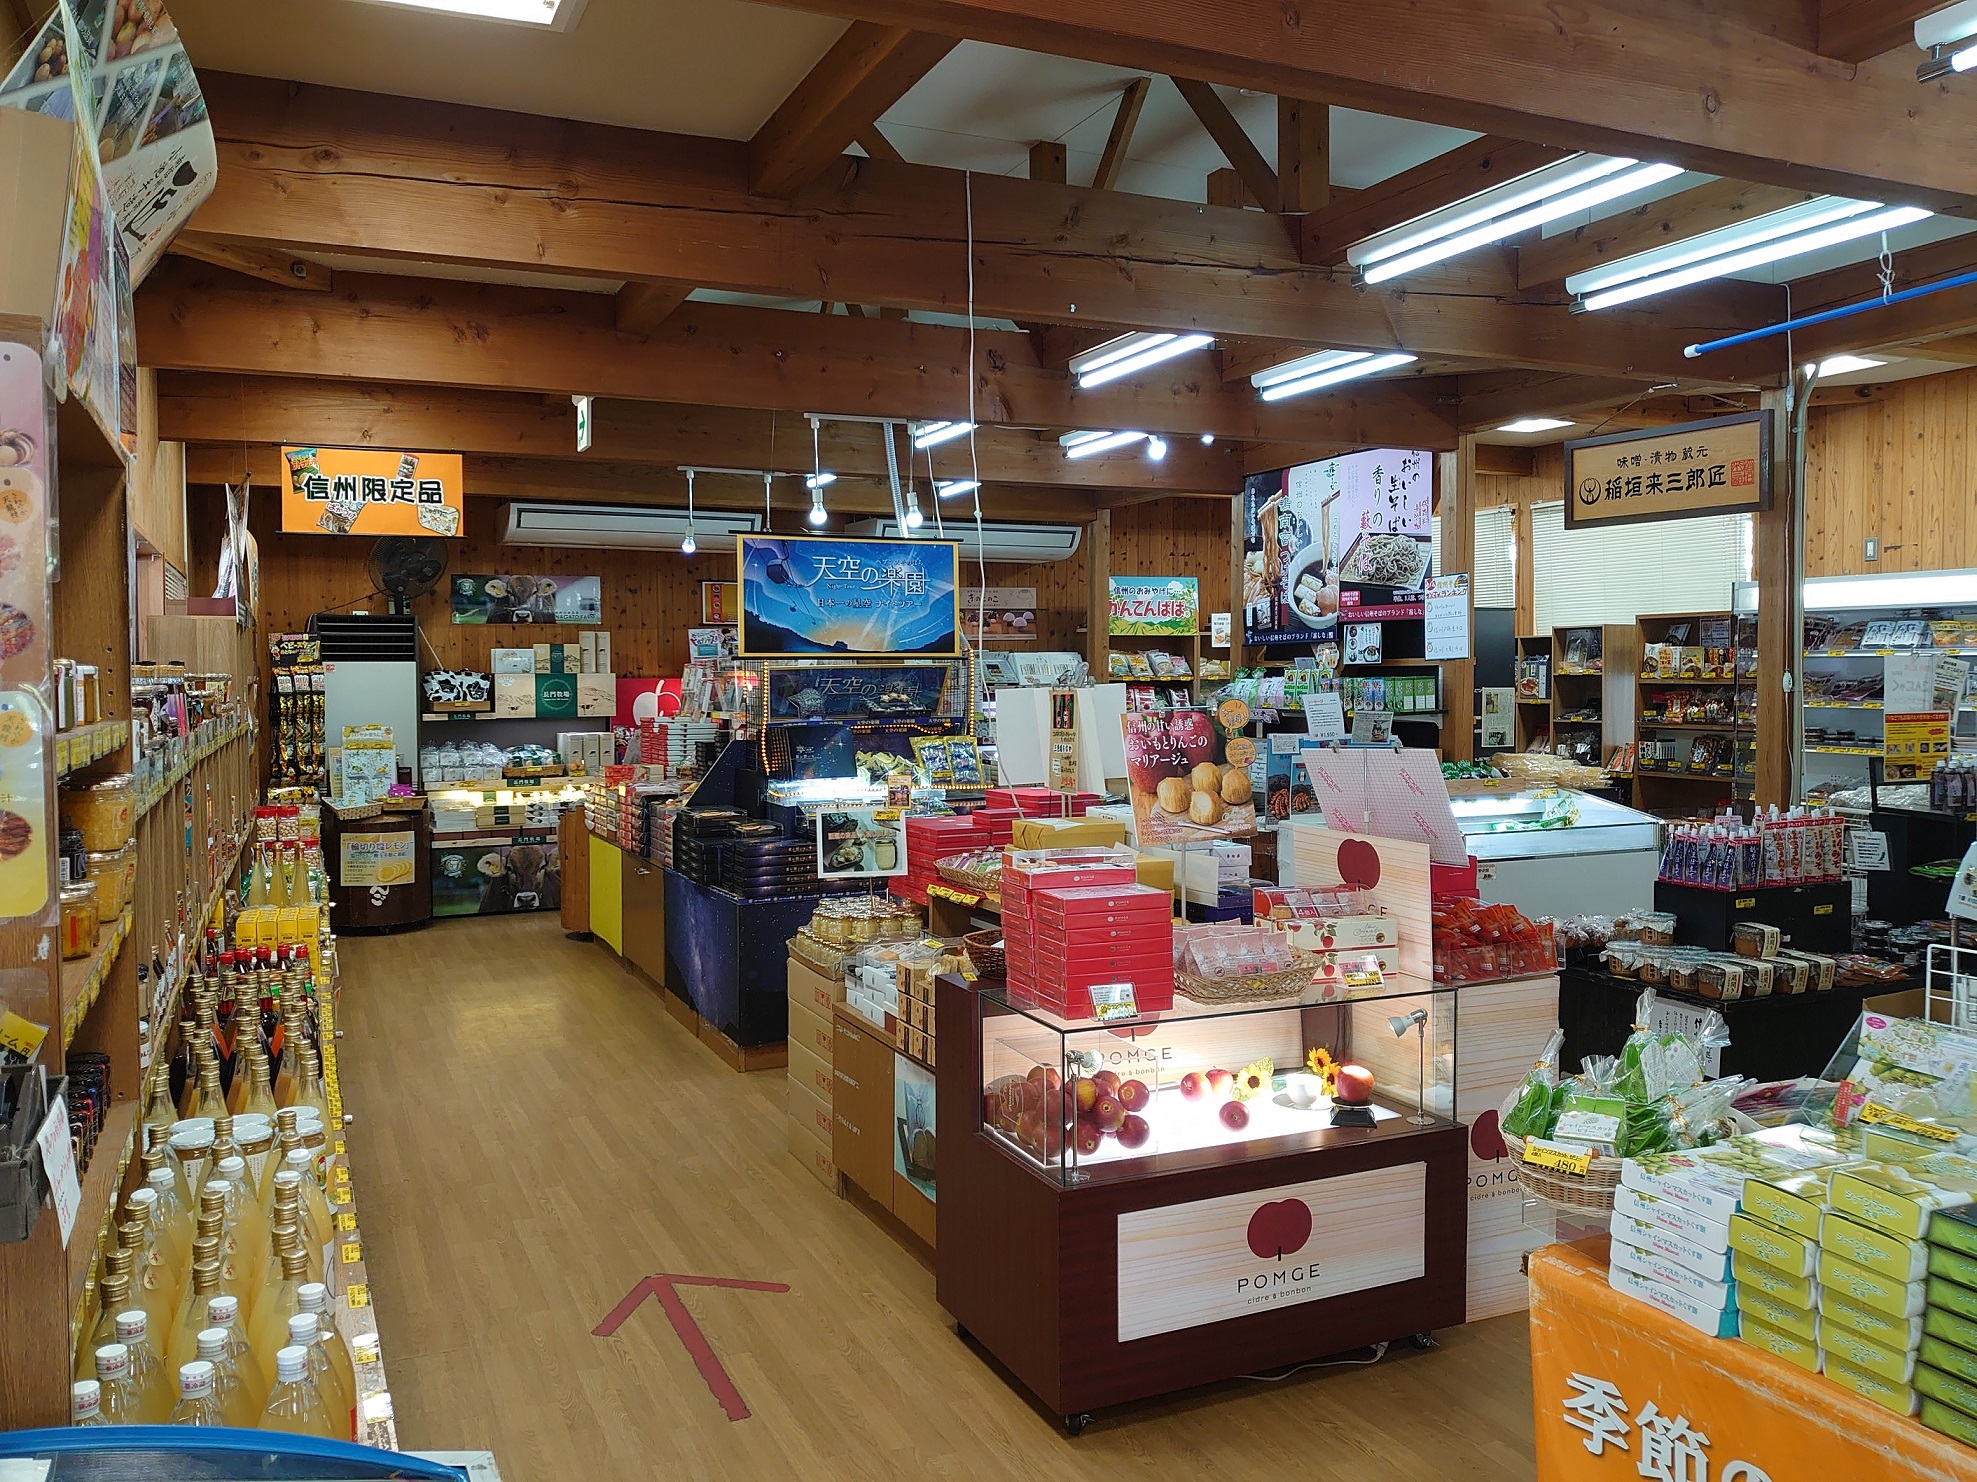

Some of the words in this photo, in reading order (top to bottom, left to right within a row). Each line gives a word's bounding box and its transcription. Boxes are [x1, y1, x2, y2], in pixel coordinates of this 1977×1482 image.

[303, 475, 443, 505] 信州限定品
[1401, 458, 1412, 528] おいしい
[1604, 464, 1727, 501] 稲垣来三郎匠
[1372, 465, 1384, 527] 香りの
[805, 555, 931, 596] 天空の楽園
[817, 598, 872, 608] 日本一の星空
[1127, 718, 1194, 734] 信州の甘い誘惑
[1129, 735, 1208, 751] おいもとりんごの
[1130, 752, 1189, 768] マリアージュ
[1318, 771, 1335, 793] PANEL
[1319, 767, 1342, 793] STICKER
[1399, 773, 1416, 795] PANEL
[1401, 768, 1424, 795] STICKER
[1413, 816, 1431, 838] PANEL
[1415, 812, 1438, 839] STICKER
[1101, 1046, 1172, 1066] OMGE
[1554, 1159, 1577, 1171] 480
[1470, 1191, 1488, 1201] cidre
[1238, 1263, 1320, 1293] POMGE
[1248, 1294, 1270, 1304] cidre
[1280, 1286, 1312, 1298] bonbon
